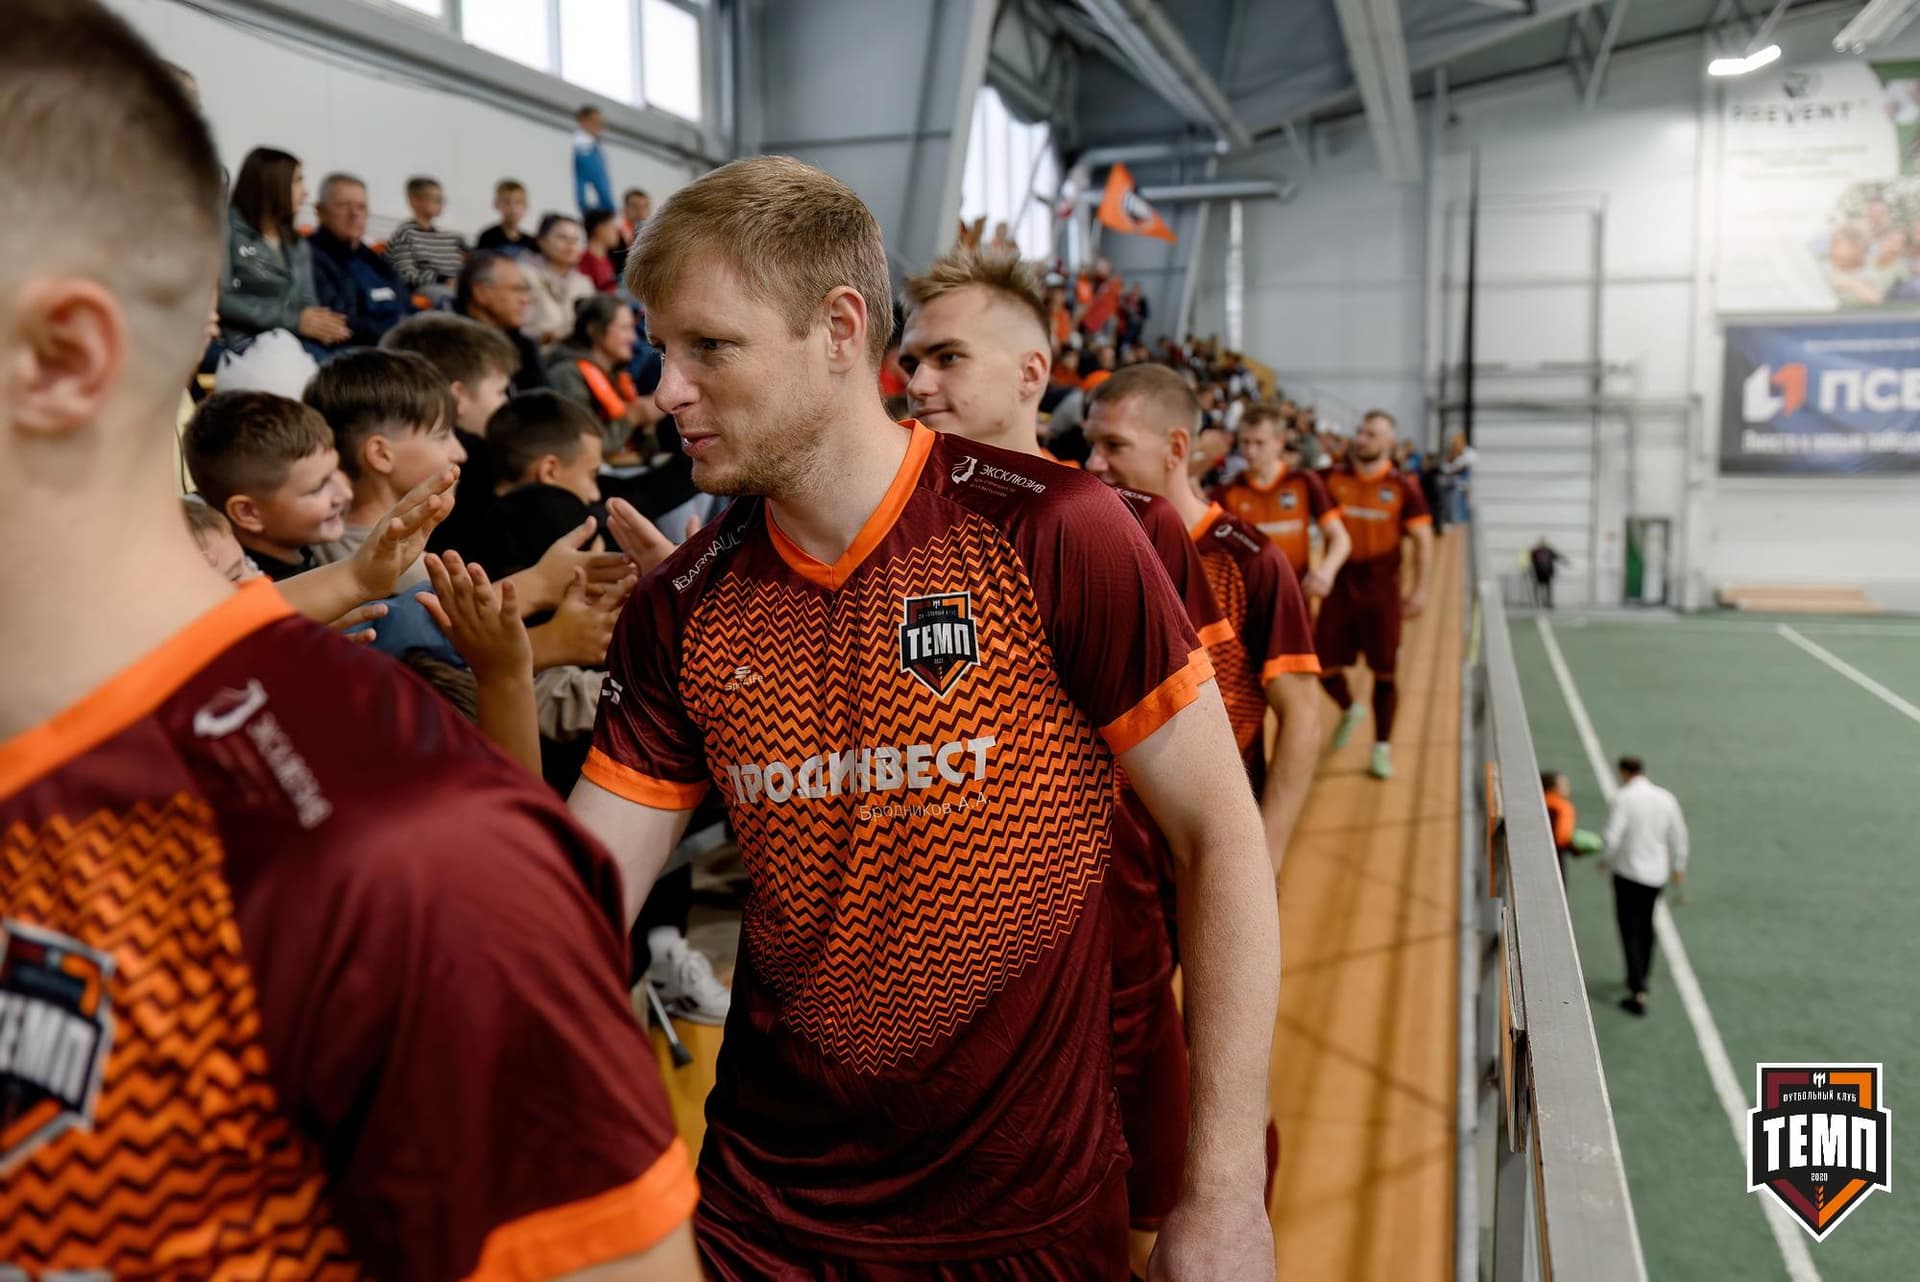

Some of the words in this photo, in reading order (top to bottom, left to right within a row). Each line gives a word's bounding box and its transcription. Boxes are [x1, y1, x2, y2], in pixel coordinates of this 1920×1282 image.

[979, 464, 1046, 495] ЭКСКЛЮЗИВ
[907, 623, 971, 661] ТЕМП
[859, 803, 952, 822] Бродников
[0, 990, 95, 1104] ЕМП
